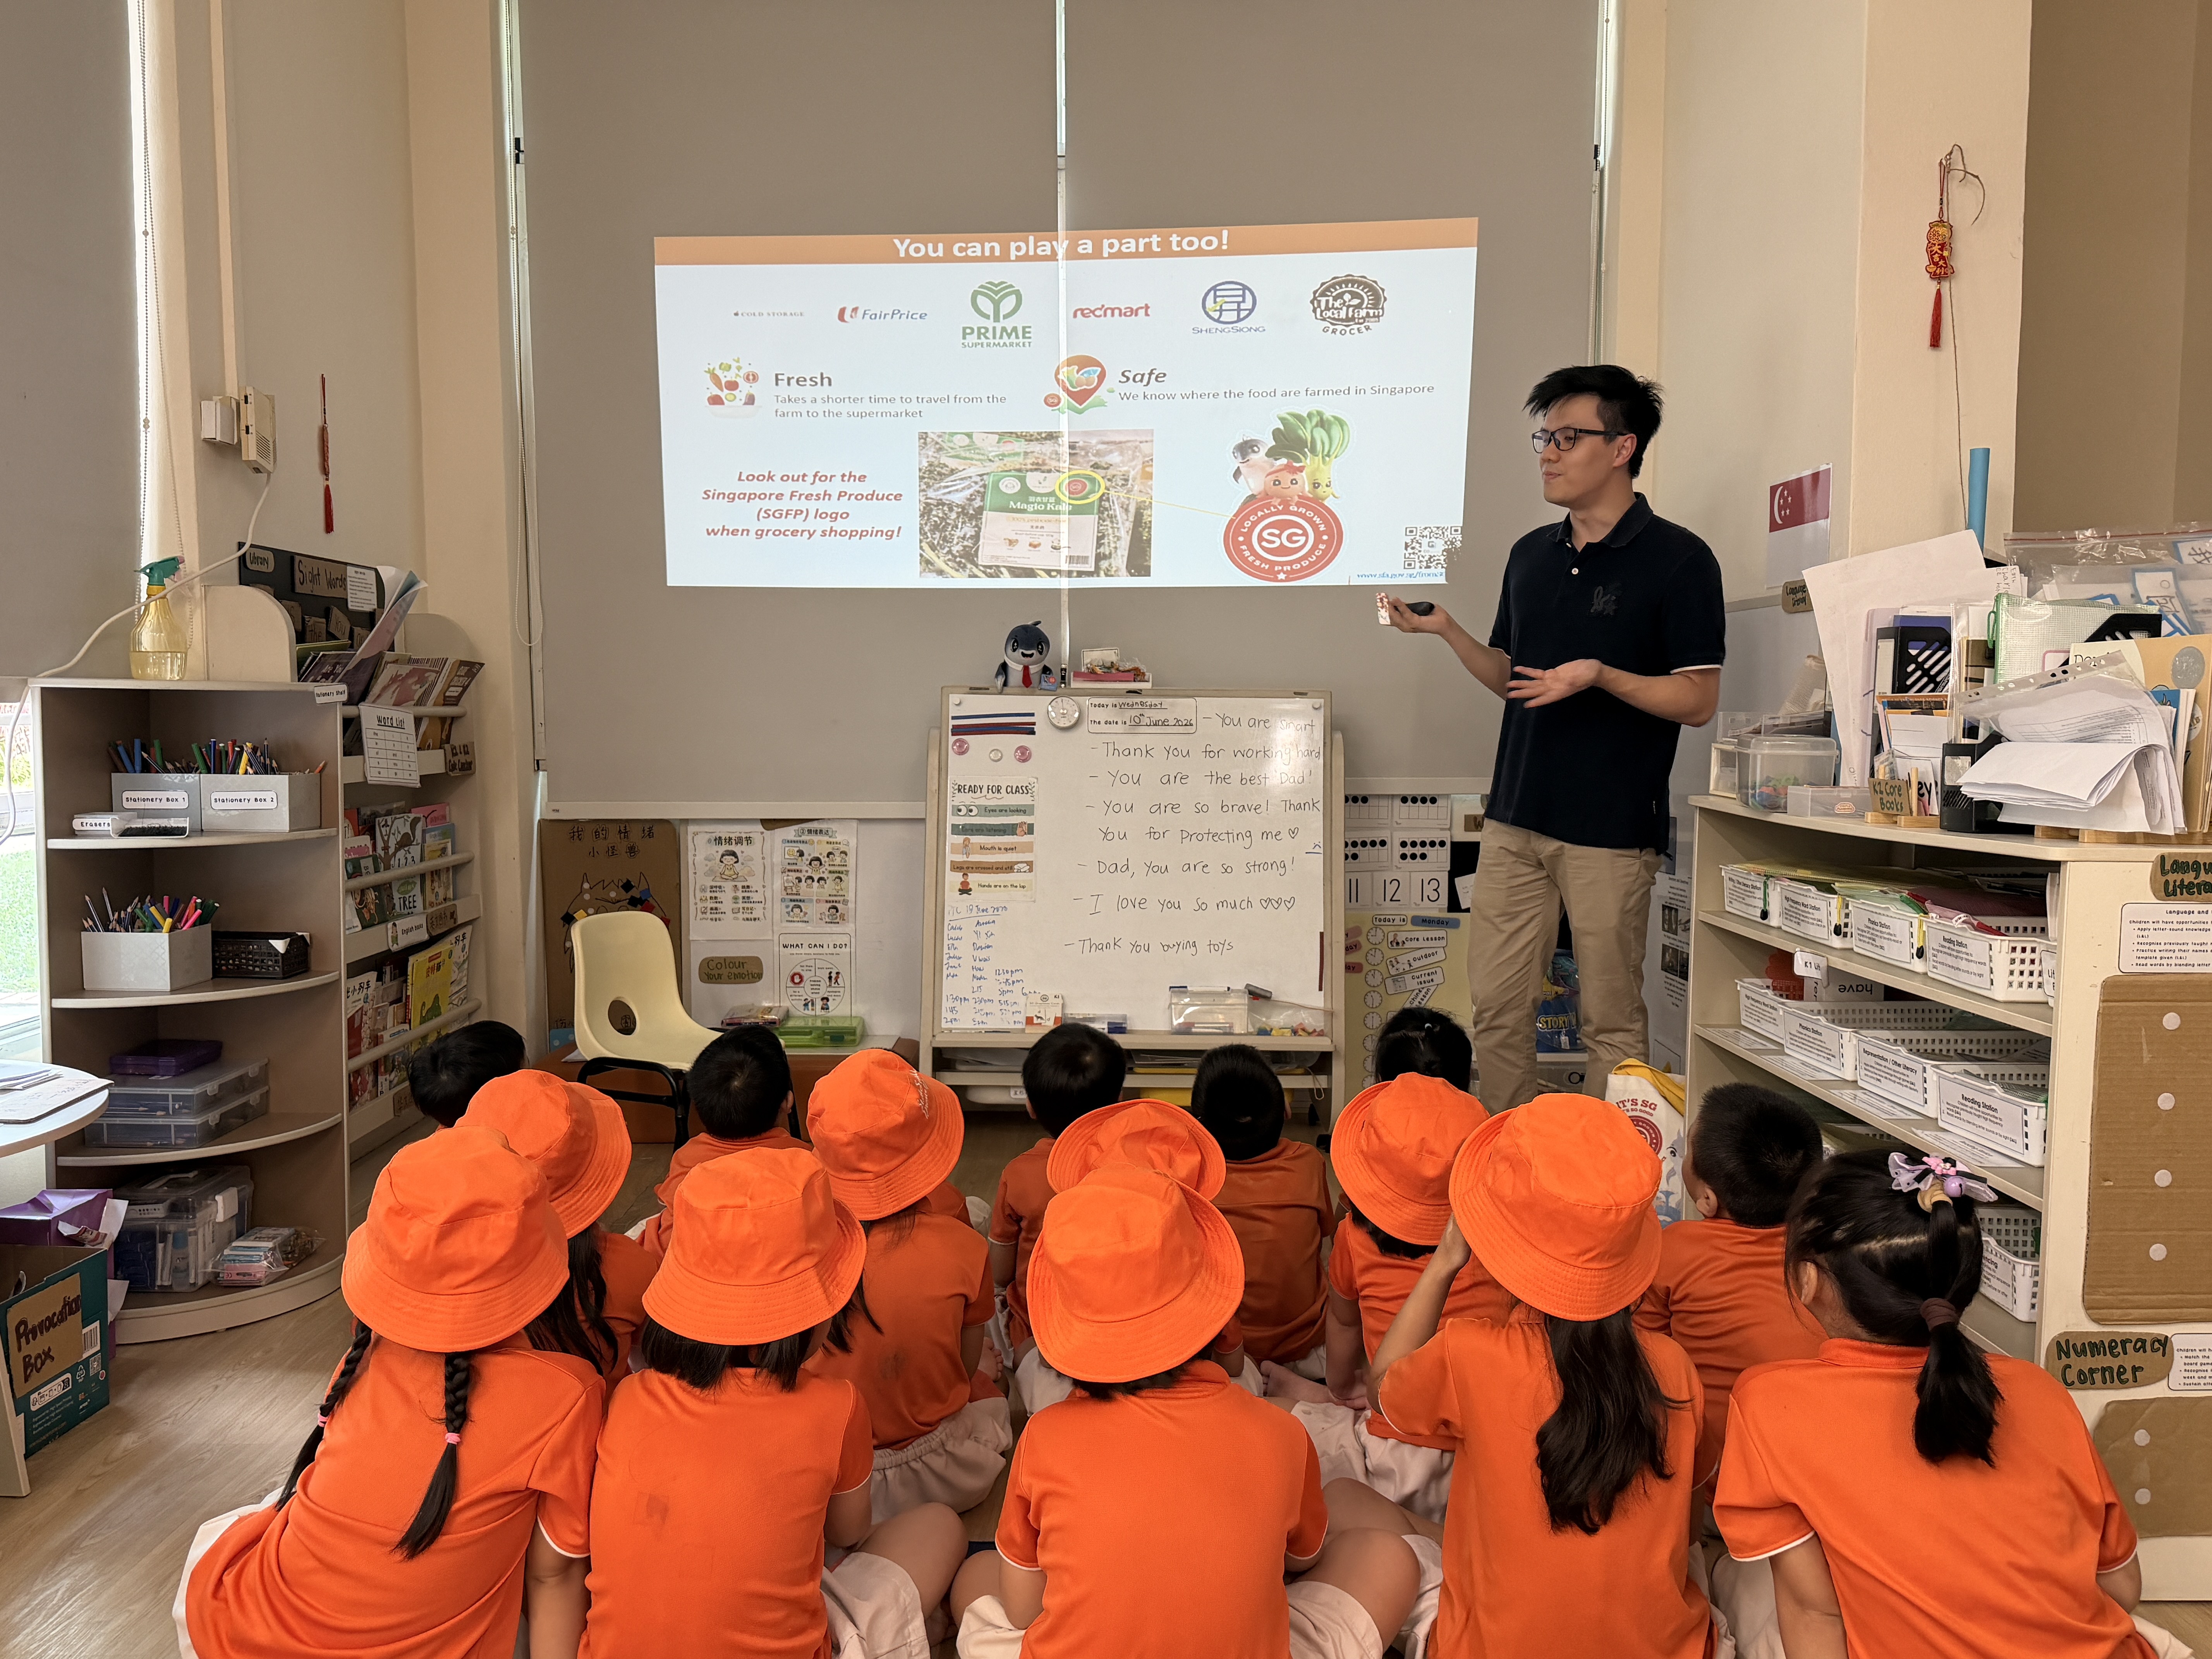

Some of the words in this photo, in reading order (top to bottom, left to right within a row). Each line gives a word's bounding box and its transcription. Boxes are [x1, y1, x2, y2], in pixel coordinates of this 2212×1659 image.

[893, 238, 943, 258] You
[953, 240, 1000, 257] can
[1010, 236, 1068, 260] play
[1078, 238, 1092, 253] a
[1102, 234, 1161, 257] part
[1170, 230, 1228, 251] too!
[1072, 303, 1150, 319] redmart
[1317, 296, 1343, 310] The
[862, 309, 927, 321] FairPrice
[1316, 306, 1347, 319] Local
[962, 325, 1032, 340] PRIME
[1322, 325, 1372, 336] GROCER
[774, 371, 832, 388] Fresh
[1118, 368, 1167, 387] Safe
[775, 394, 806, 405] Takes
[821, 394, 864, 404] shorter
[868, 394, 896, 404] time
[900, 395, 912, 404] to
[916, 394, 950, 404] travel
[953, 394, 983, 404] from
[987, 393, 1006, 403] the
[1119, 391, 1138, 401] We
[1143, 390, 1176, 401] know
[1180, 389, 1219, 400] where
[1224, 388, 1243, 399] the
[1248, 388, 1276, 399] food
[1281, 389, 1301, 398] are
[1304, 386, 1351, 397] farmed
[1355, 385, 1366, 396] in
[1370, 383, 1435, 397] Singapore
[774, 408, 801, 419] farm
[806, 409, 819, 419] to
[822, 408, 842, 418] the
[847, 408, 923, 419] supermarket
[737, 471, 776, 483] Look
[780, 472, 808, 483] out
[810, 471, 836, 485] for
[840, 471, 867, 483] the
[702, 489, 785, 503] Singapore
[789, 489, 832, 502] Fresh
[837, 489, 903, 502] Produce
[756, 507, 810, 522] (SGFP)
[814, 508, 850, 522] logo
[1240, 504, 1285, 533] LOCALLY
[1289, 505, 1326, 531] GROWN
[706, 525, 750, 538] when
[755, 527, 817, 540] grocery
[819, 526, 902, 540] shopping!
[1261, 528, 1306, 548] SG
[1240, 544, 1270, 572] FRESH
[1274, 543, 1326, 572] PRODUCE
[298, 560, 321, 592] Sight
[325, 568, 347, 591] Words
[376, 714, 393, 726] Word
[396, 717, 405, 728] List
[1146, 716, 1169, 726] June
[1173, 717, 1194, 726] 2026
[1215, 713, 1242, 728] You
[1248, 718, 1271, 729] are
[1280, 719, 1316, 734] smart
[1102, 741, 1155, 758] Thank
[1201, 743, 1226, 759] for
[1233, 745, 1292, 766] working
[1296, 744, 1321, 761] hard
[1108, 769, 1141, 787] You
[1160, 772, 1189, 785] are
[1204, 771, 1232, 785] the
[1240, 772, 1270, 787] best
[1280, 769, 1312, 785] Dad!
[957, 784, 984, 794] READY
[987, 785, 1002, 794] FOR
[1005, 785, 1030, 795] CLASS
[1884, 781, 1903, 798] Core
[1103, 800, 1133, 816] You
[1149, 802, 1181, 814] are
[1195, 802, 1209, 813] so
[1221, 799, 1269, 815] brave!
[1281, 798, 1321, 813] Thank
[1879, 797, 1904, 812] Books
[569, 824, 655, 842] 我的情绪
[714, 836, 753, 846] 情绪调节
[1099, 826, 1128, 841] You
[1145, 826, 1171, 840] for
[1261, 830, 1283, 841] me
[588, 842, 640, 859] 小怪兽
[1097, 858, 1135, 878] Dad,
[1182, 861, 1211, 874] are
[1221, 864, 1233, 874] so
[1245, 857, 1295, 876] strong!
[1383, 878, 1401, 903] 12
[1421, 878, 1441, 902] 13
[398, 894, 417, 911] TREE
[1090, 894, 1104, 915] I
[1117, 895, 1148, 912] love
[1194, 898, 1208, 912] so
[1216, 896, 1253, 910] much
[1421, 918, 1449, 926] Monday
[1079, 938, 1122, 954] Thank
[1161, 939, 1198, 957] buying
[1207, 939, 1234, 955] toys
[707, 958, 747, 971] Colour
[1838, 984, 1873, 995] have
[1540, 1015, 1569, 1029] STORY
[1640, 1099, 1657, 1111] SG
[1961, 1094, 1982, 1109] Reading
[2056, 1335, 2169, 1361] Numeracy
[2061, 1364, 2144, 1387] Corner
